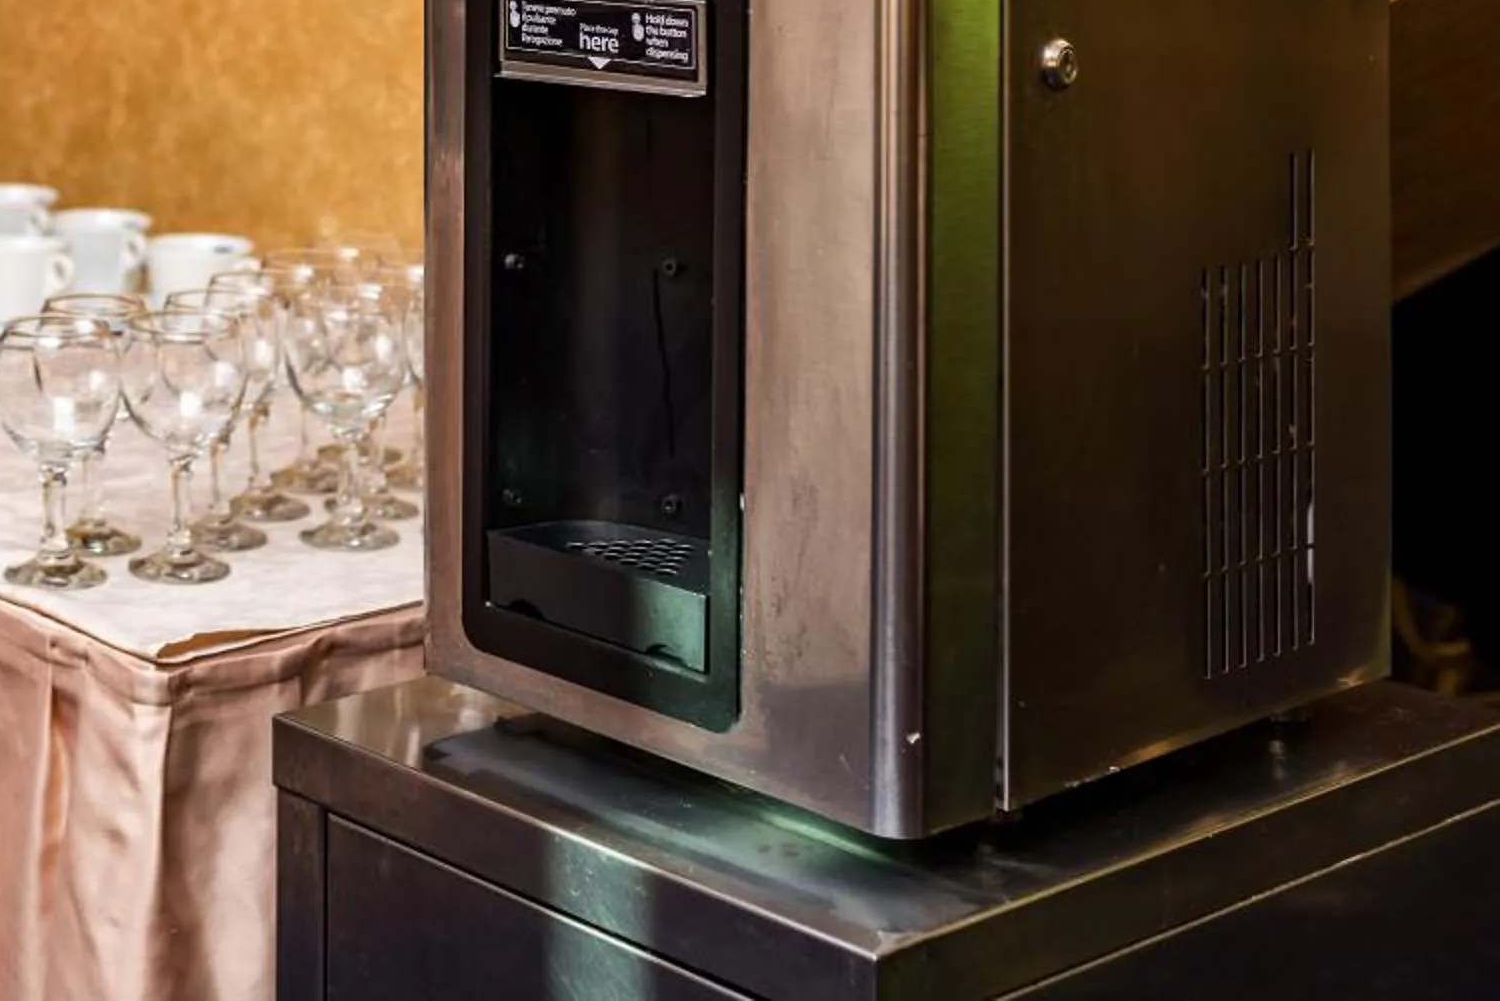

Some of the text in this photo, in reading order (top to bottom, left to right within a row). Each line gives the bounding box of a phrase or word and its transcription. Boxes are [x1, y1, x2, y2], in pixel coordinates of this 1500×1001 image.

[645, 13, 689, 27] Hold down
[645, 24, 686, 38] the button
[579, 32, 619, 53] here
[645, 37, 669, 48] when
